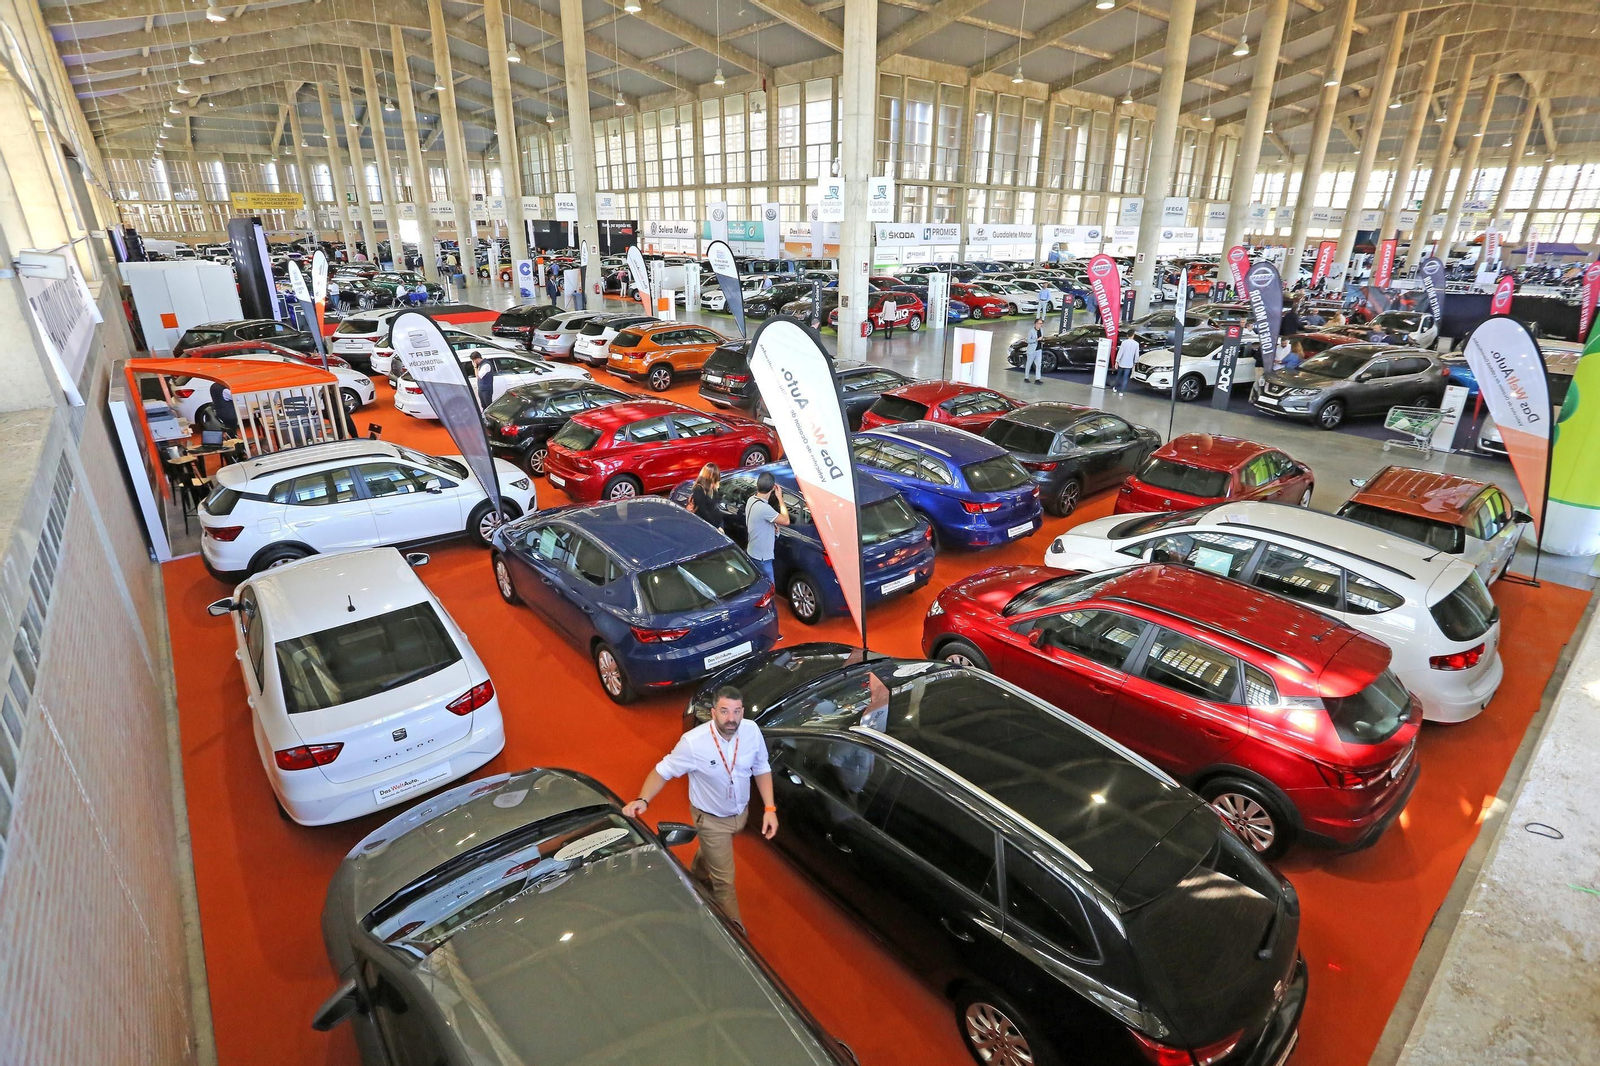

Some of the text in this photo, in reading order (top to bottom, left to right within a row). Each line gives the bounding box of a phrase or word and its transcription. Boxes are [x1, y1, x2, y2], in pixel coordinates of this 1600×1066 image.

[658, 226, 673, 234] Solera
[1315, 245, 1331, 282] ONDA
[1217, 367, 1232, 392] ADC
